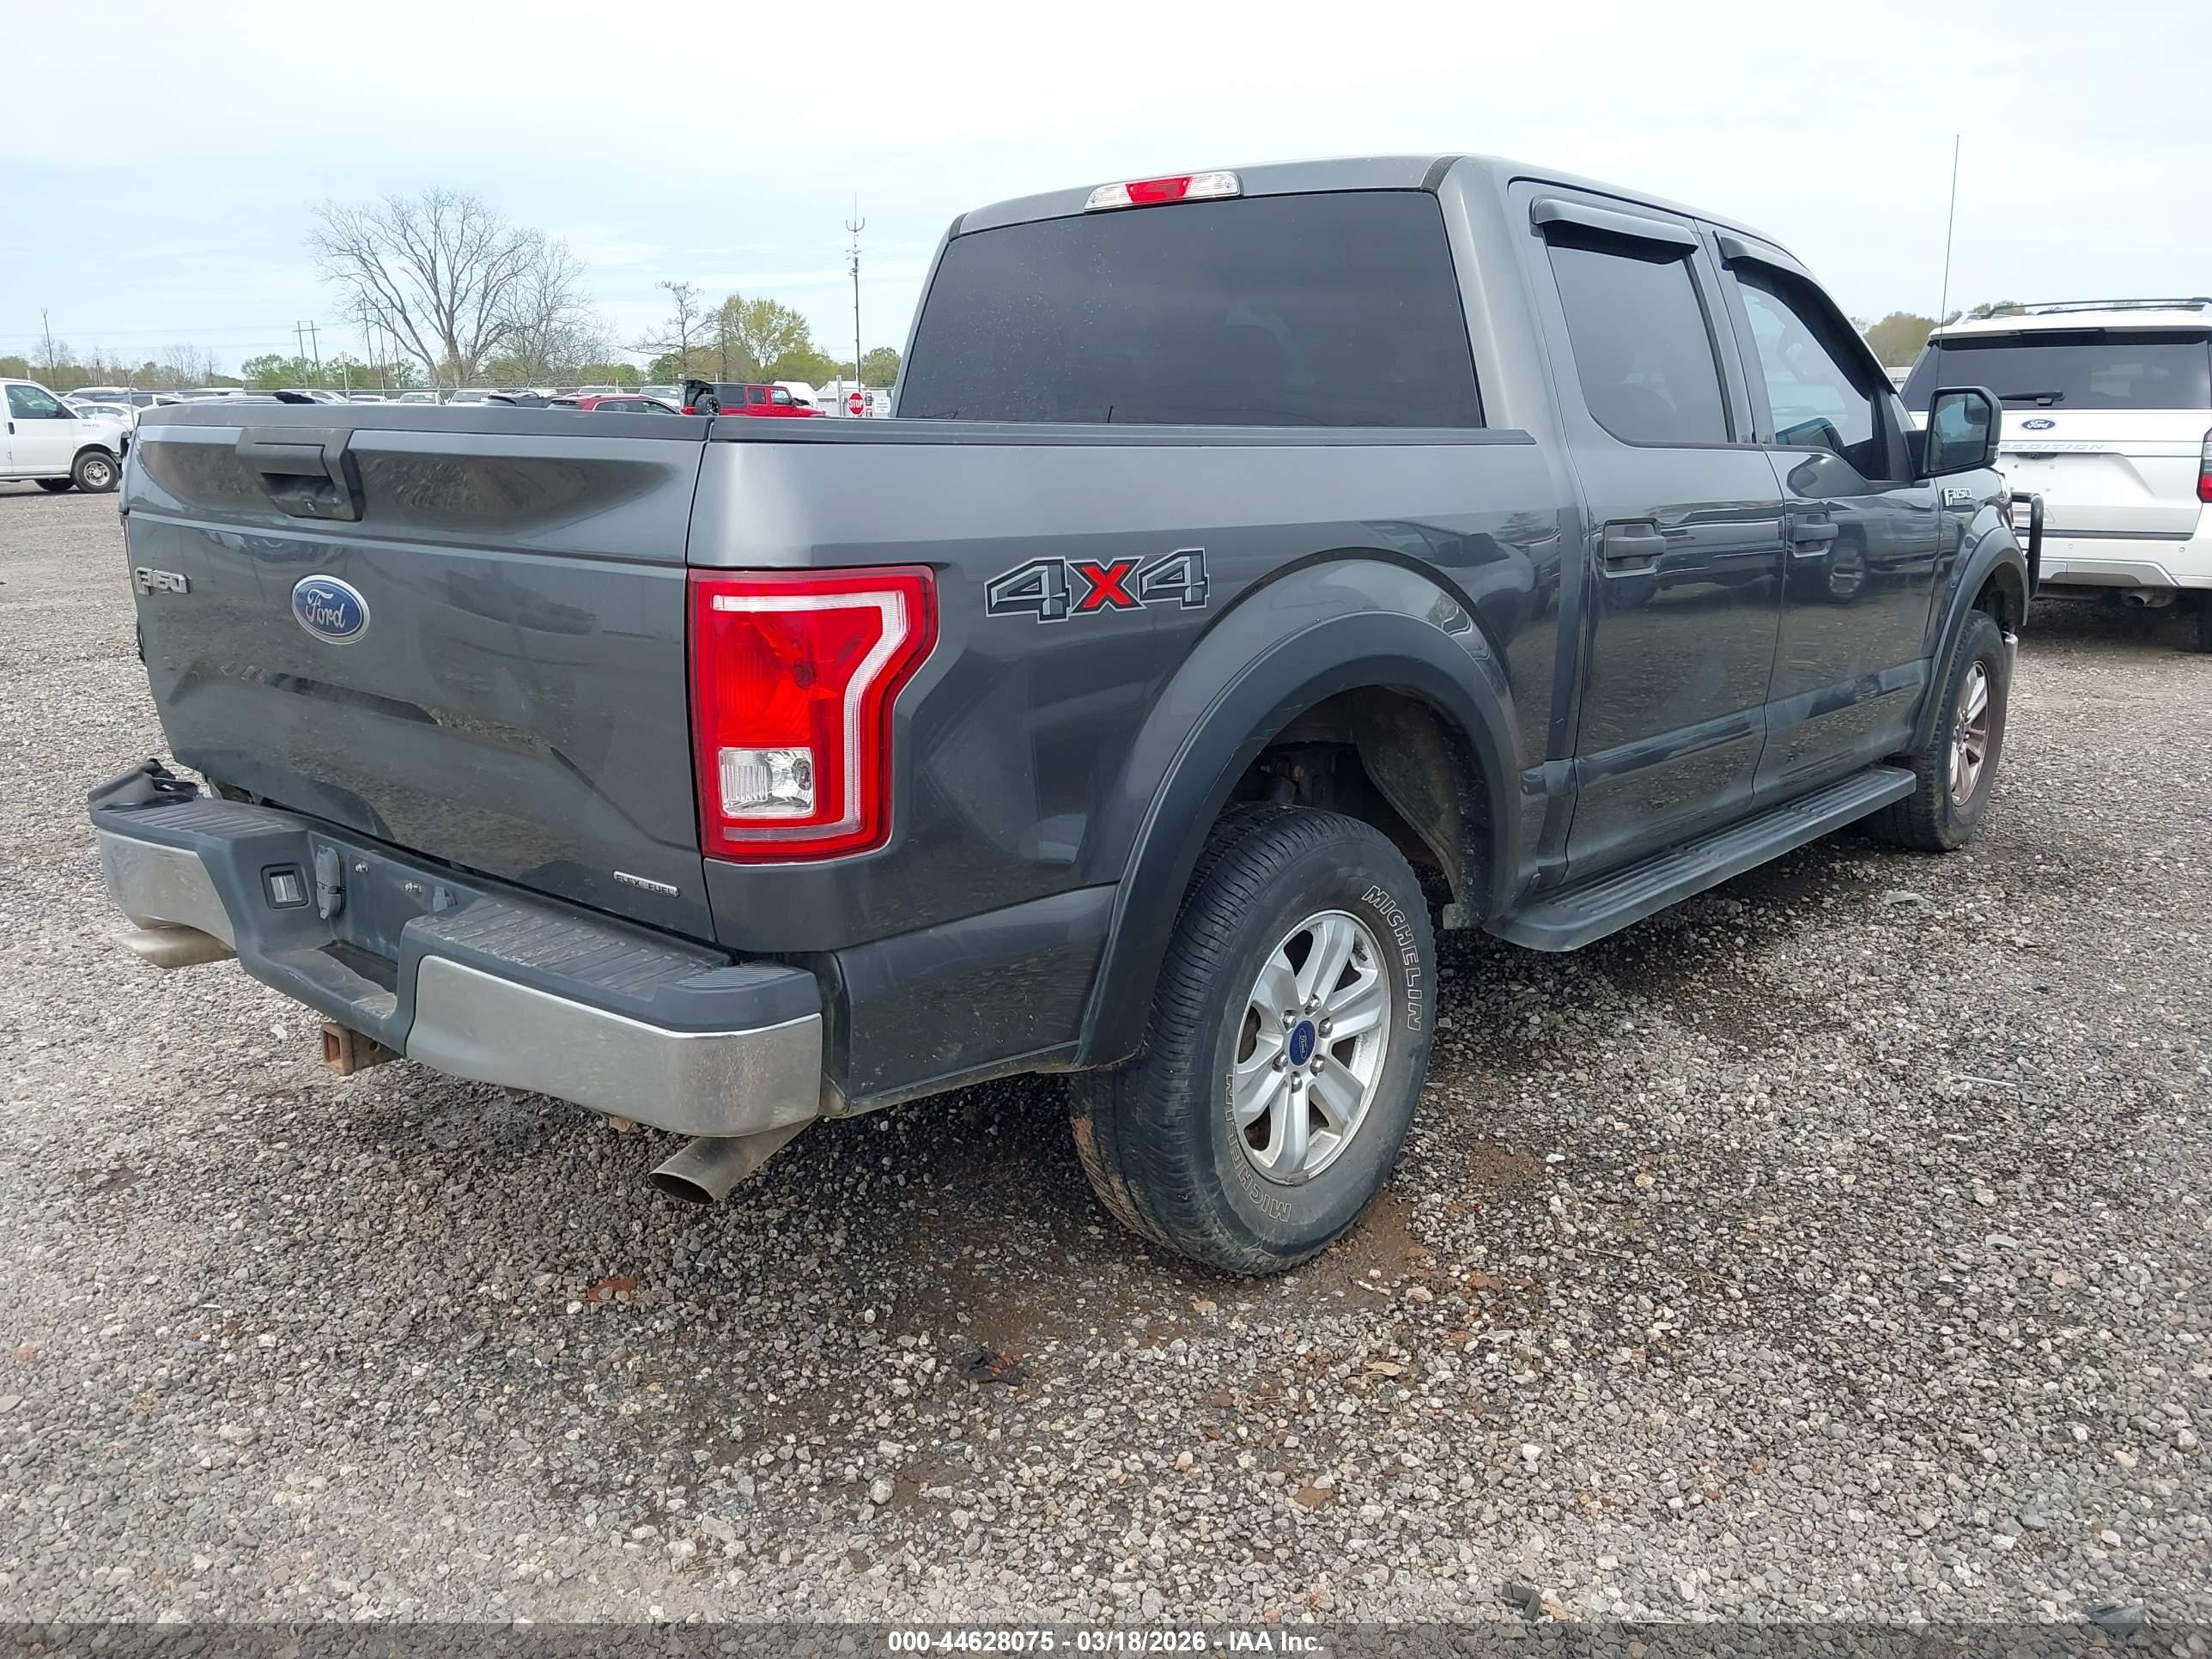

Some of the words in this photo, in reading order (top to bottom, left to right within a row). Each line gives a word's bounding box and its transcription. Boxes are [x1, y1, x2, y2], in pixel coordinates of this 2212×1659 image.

[849, 399, 864, 409] STOP
[304, 588, 347, 629] Ford
[615, 874, 641, 887] FLEX
[648, 884, 675, 896] FUEL
[1361, 885, 1423, 1031] MICHELIN
[1224, 1074, 1291, 1223] MICHELIN
